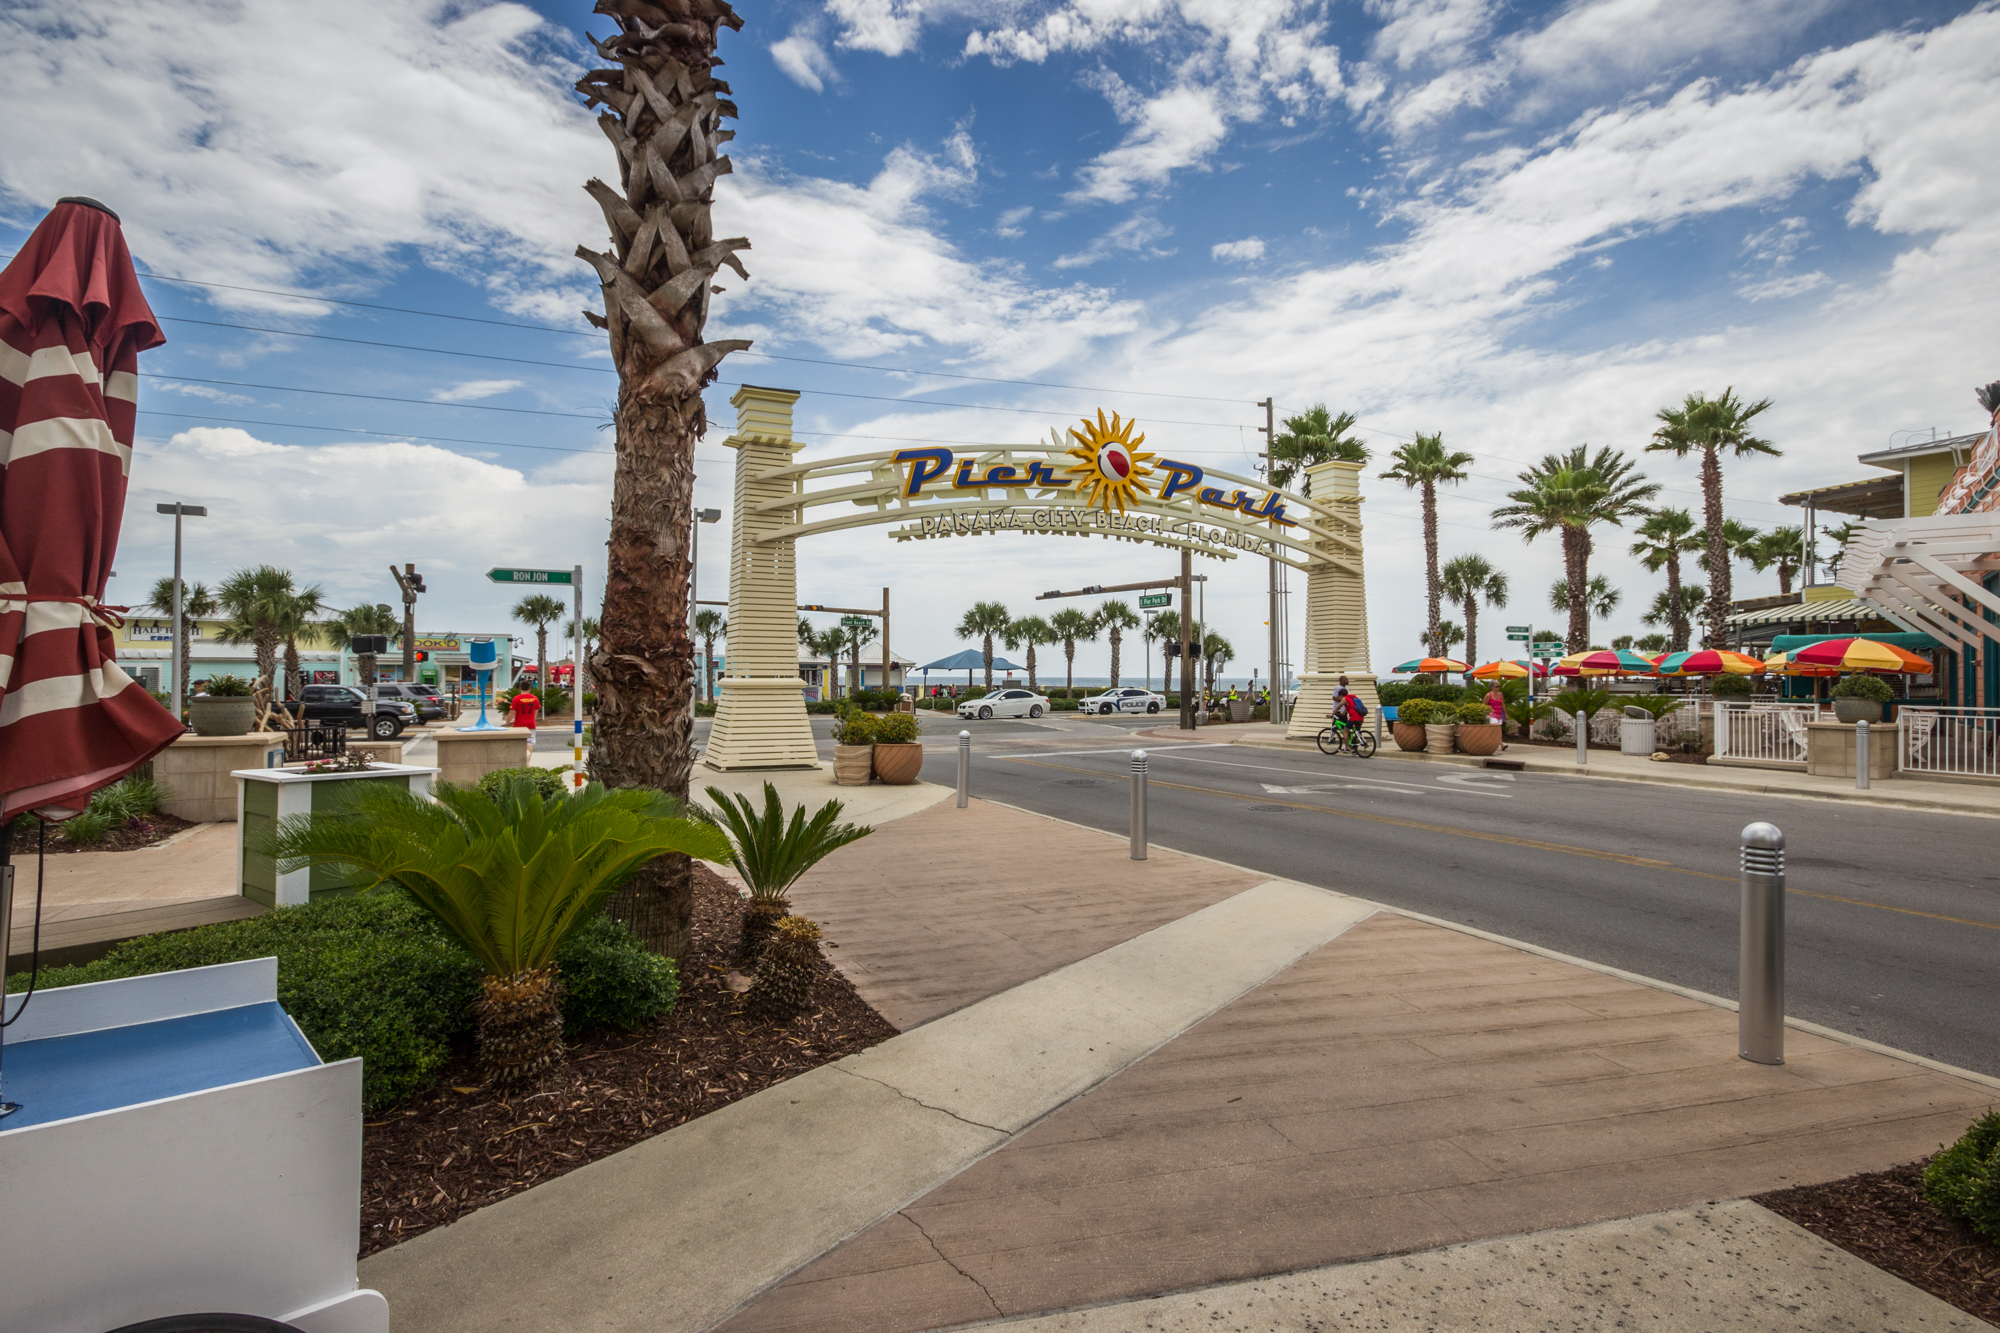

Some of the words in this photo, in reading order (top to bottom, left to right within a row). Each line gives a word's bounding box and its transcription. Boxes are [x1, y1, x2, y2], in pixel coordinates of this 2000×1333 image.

[888, 446, 1072, 498] Pier
[1152, 457, 1298, 528] Park
[921, 509, 1023, 534] PANAMA
[1033, 510, 1085, 527] CITY
[1096, 511, 1164, 534] BEACH
[1188, 523, 1270, 556] FLORIDA
[513, 571, 530, 581] RON
[532, 573, 548, 582] JON
[521, 703, 534, 714] 17
